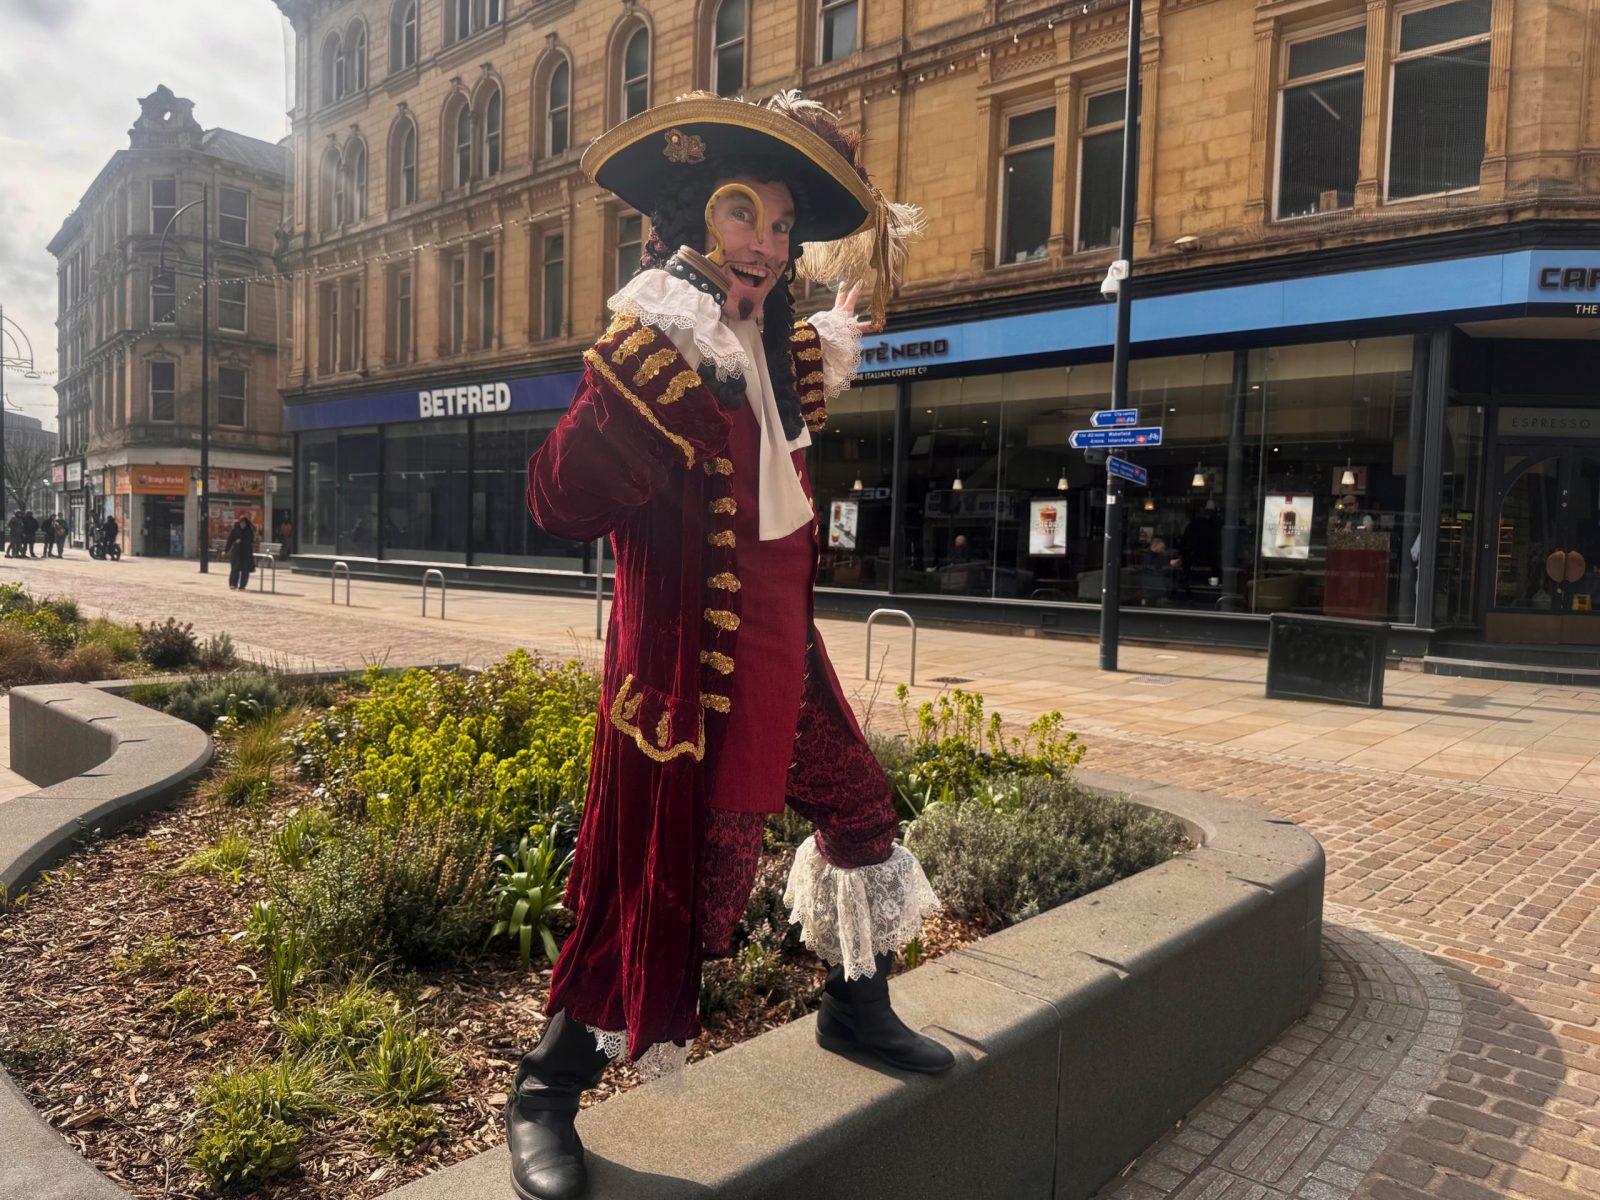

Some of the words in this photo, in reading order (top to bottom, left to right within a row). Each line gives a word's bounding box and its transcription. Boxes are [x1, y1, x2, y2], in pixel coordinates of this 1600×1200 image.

[1575, 304, 1599, 314] THE
[892, 339, 947, 360] NERO
[864, 371, 891, 380] ITALIAN
[891, 368, 916, 377] COFFEE
[418, 382, 512, 418] BETFRED
[1511, 417, 1591, 429] ESPRESSO
